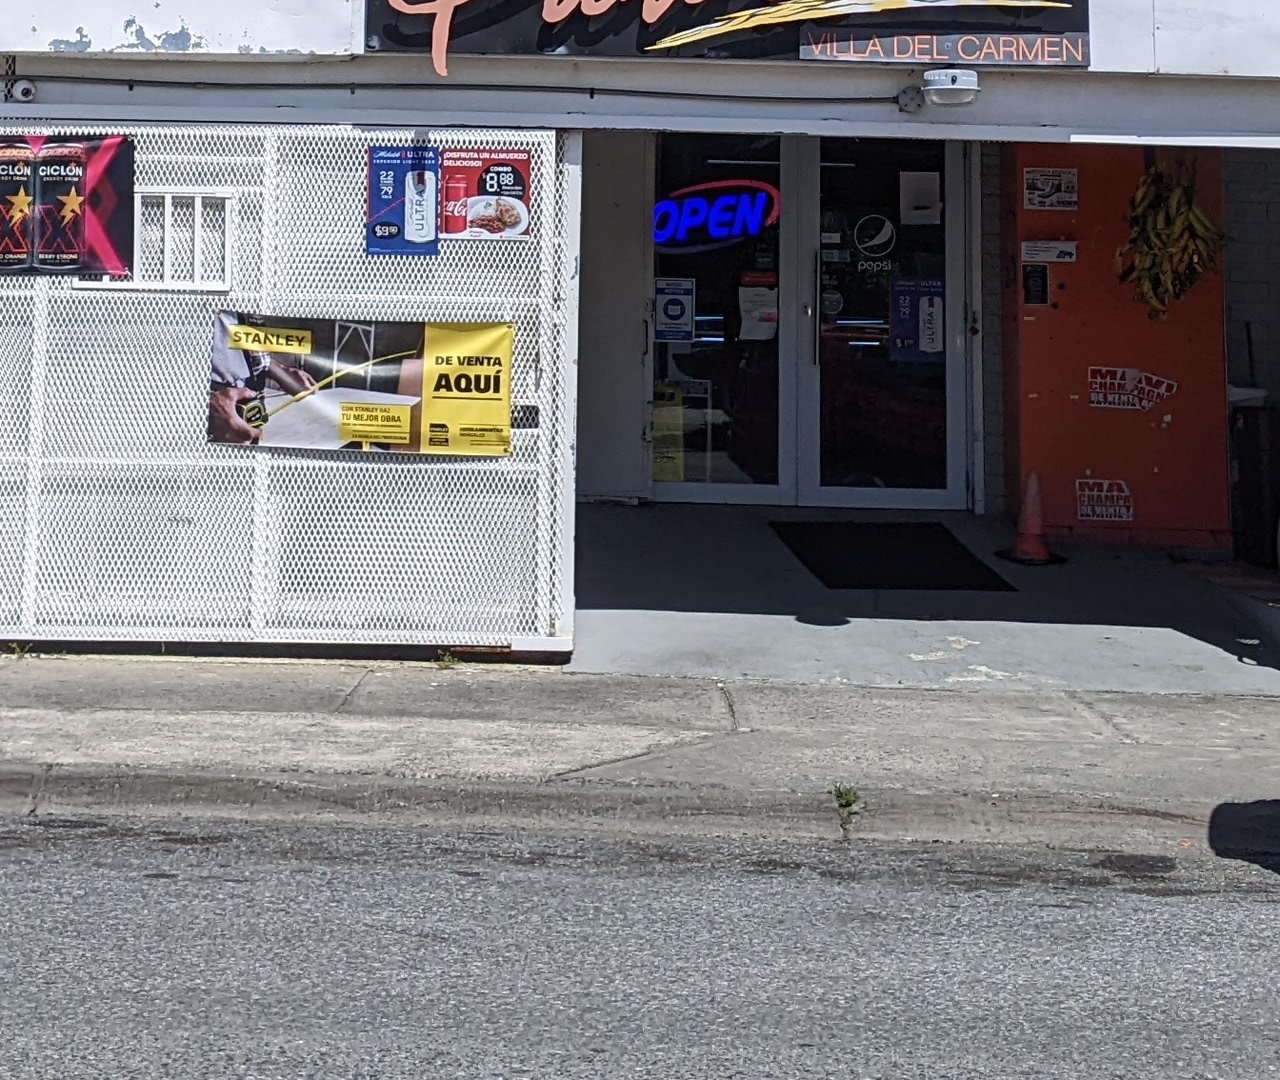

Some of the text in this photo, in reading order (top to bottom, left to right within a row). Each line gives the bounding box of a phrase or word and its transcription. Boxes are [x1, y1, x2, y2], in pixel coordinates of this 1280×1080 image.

[807, 32, 1083, 62] VILLA DEL CARMEN
[407, 150, 435, 158] ULTRA
[380, 186, 393, 195] 79
[415, 191, 425, 231] ULTRA
[653, 191, 768, 244] OPEN
[857, 260, 892, 272] pepsi
[233, 331, 305, 348] STANLEY
[435, 355, 503, 367] DE VENTA
[432, 369, 503, 394] AQUÍ
[341, 413, 402, 423] TU MEJOR OBRA
